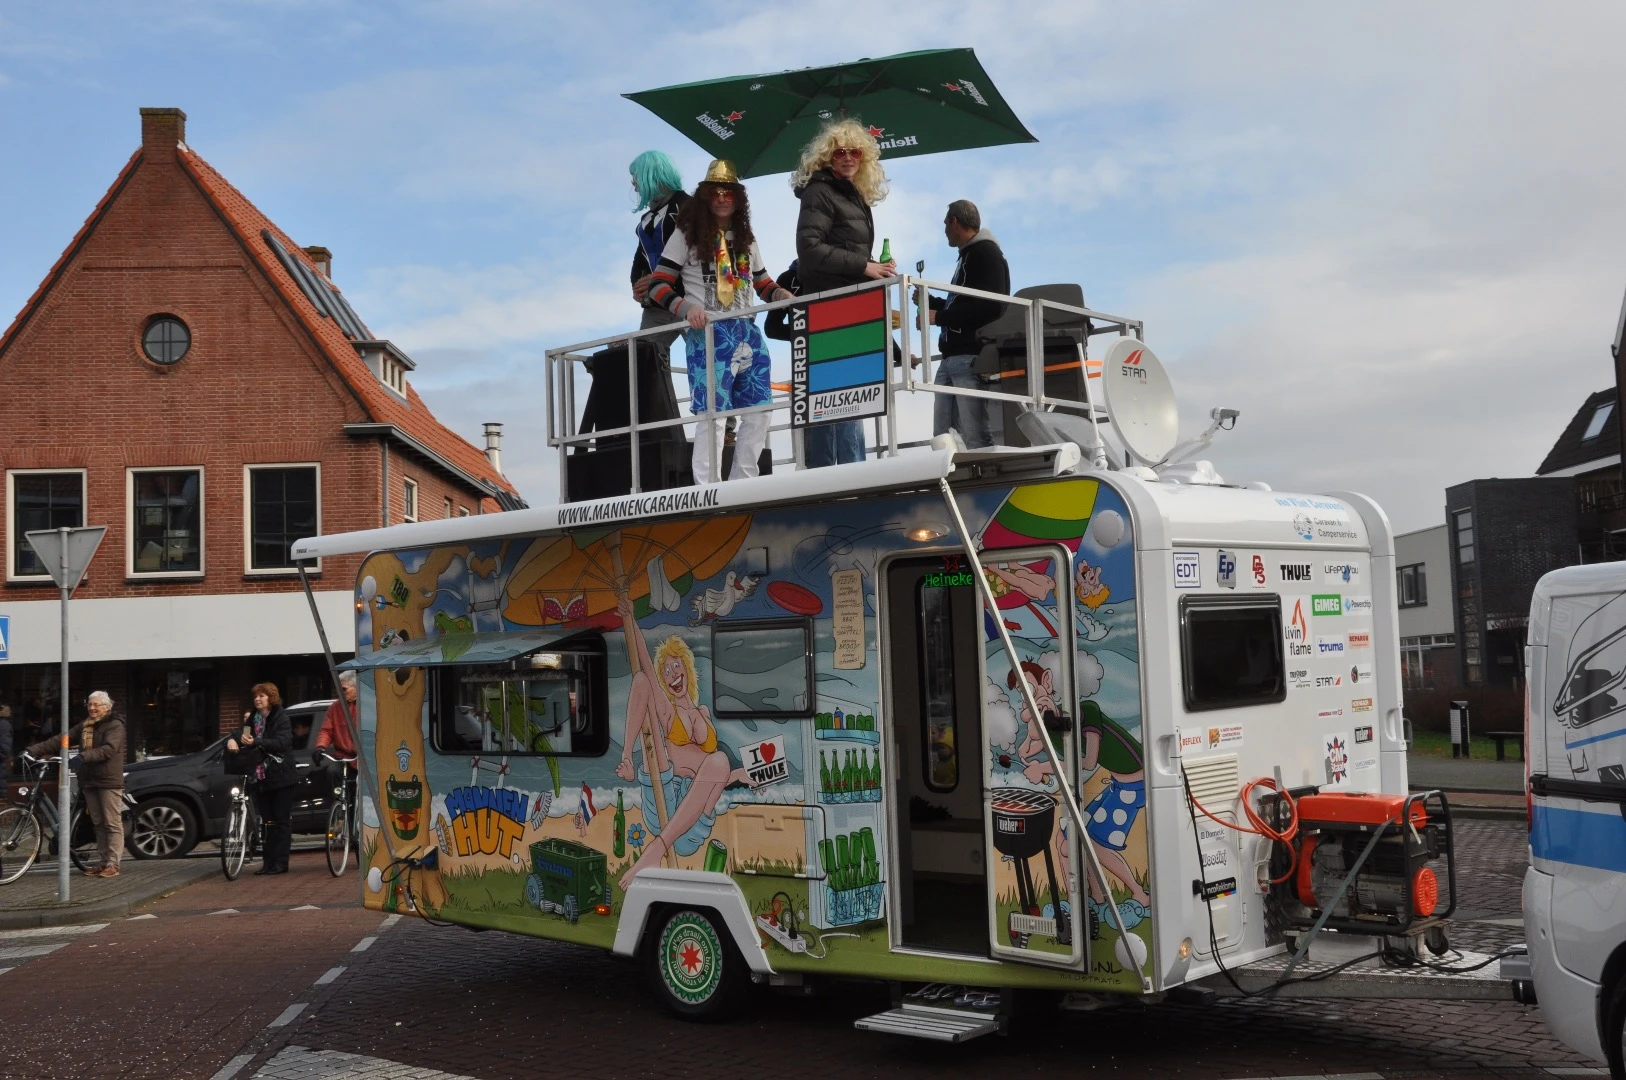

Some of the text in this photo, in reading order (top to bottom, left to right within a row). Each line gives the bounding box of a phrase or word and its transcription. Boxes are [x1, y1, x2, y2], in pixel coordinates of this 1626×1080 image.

[793, 308, 807, 426] POWERED BY
[1122, 366, 1147, 378] STAN
[814, 387, 880, 410] HULSKAMP
[823, 405, 860, 415] AUDIOVISUEEL
[557, 488, 719, 525] WWW.MANNENCARAVAN.NL
[1318, 529, 1358, 539] Camperservice
[1177, 564, 1197, 577] EDT
[1280, 564, 1311, 581] THULE
[924, 572, 973, 588] Heineke
[1314, 598, 1340, 611] GIMEG
[1351, 600, 1371, 610] Powerchip
[1284, 626, 1302, 640] livin
[1290, 642, 1312, 656] flame
[1319, 640, 1344, 652] truma
[1316, 676, 1334, 687] STAN
[749, 748, 762, 765] I
[750, 762, 786, 783] THULE
[444, 786, 529, 822] MANNEN
[999, 818, 1018, 832] weber
[452, 807, 525, 859] HUT
[1206, 828, 1225, 839] Dometic
[683, 929, 702, 940] draait
[672, 933, 683, 951] alles
[701, 941, 709, 954] om
[1091, 961, 1122, 974] .NL
[698, 975, 705, 983] en
